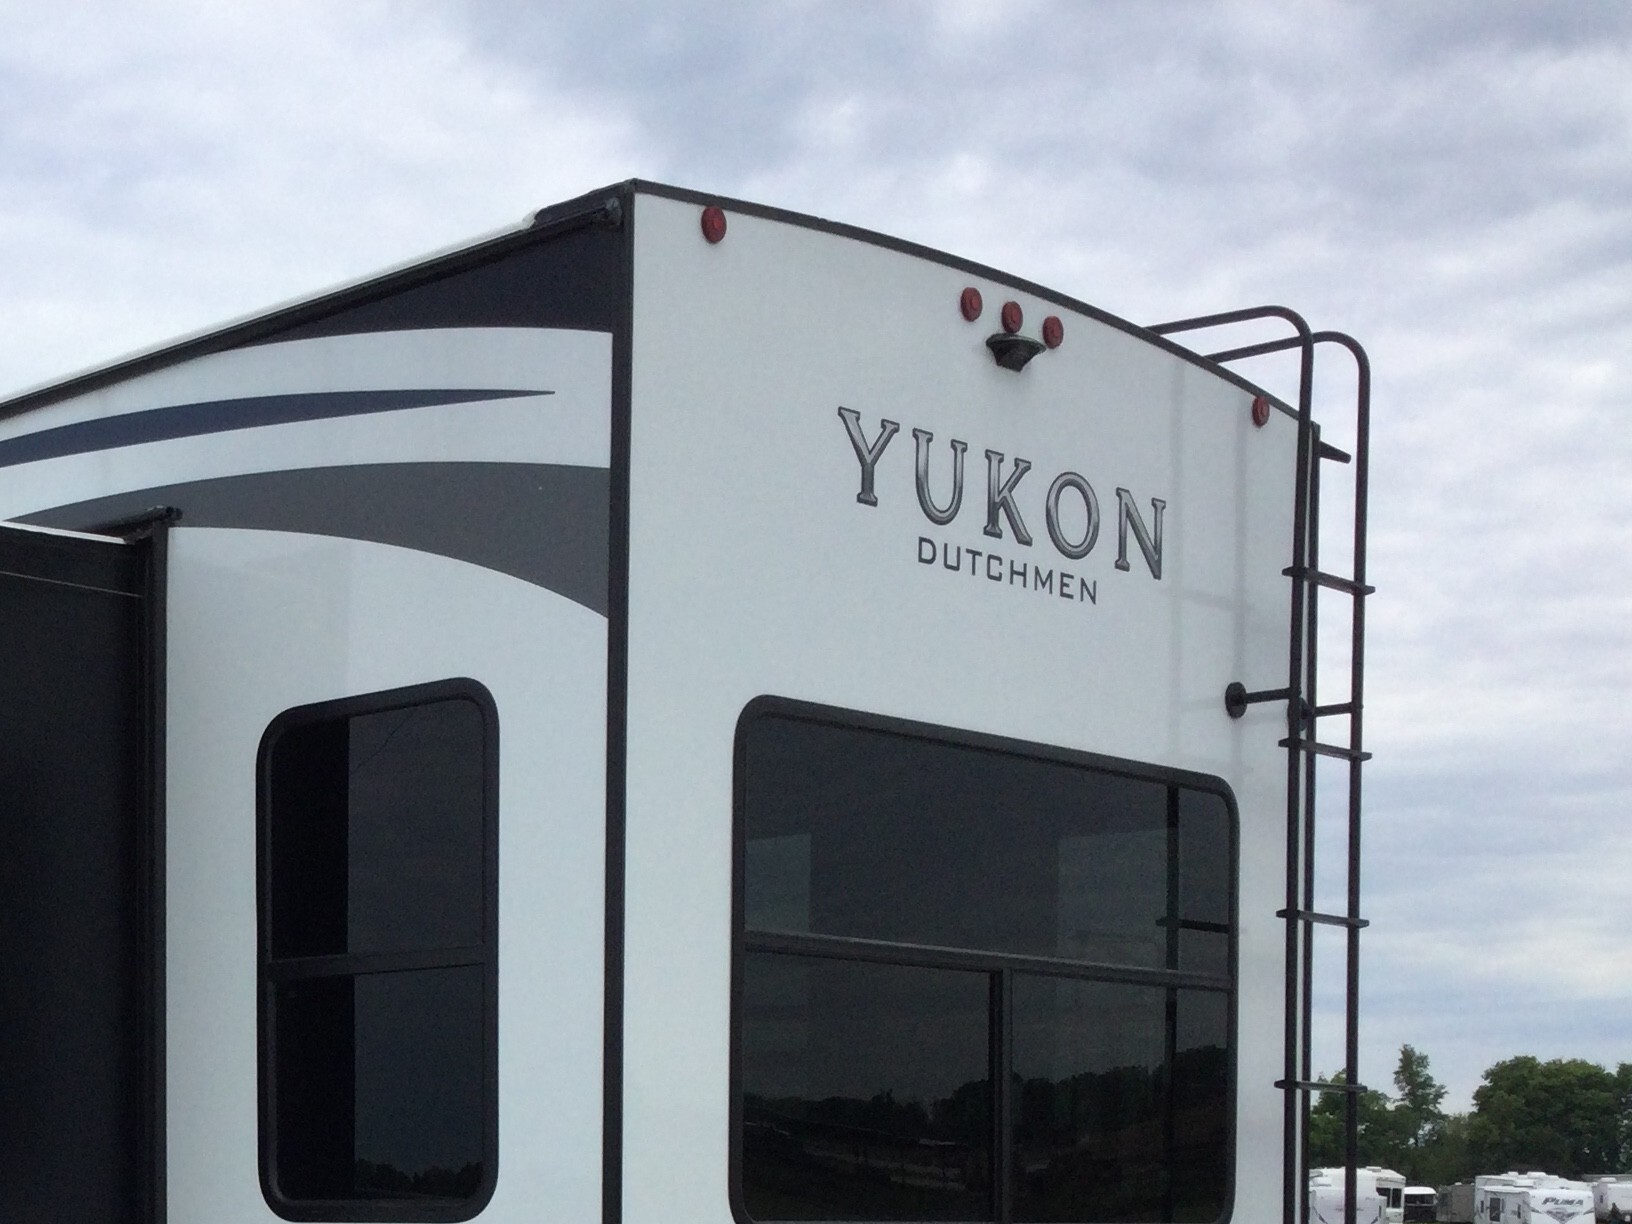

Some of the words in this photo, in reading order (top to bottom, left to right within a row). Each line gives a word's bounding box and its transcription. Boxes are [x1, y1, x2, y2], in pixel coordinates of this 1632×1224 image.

[837, 406, 1167, 580] YUKON
[917, 536, 1098, 605] DUTCHMEN
[1541, 1196, 1584, 1206] PUMA
